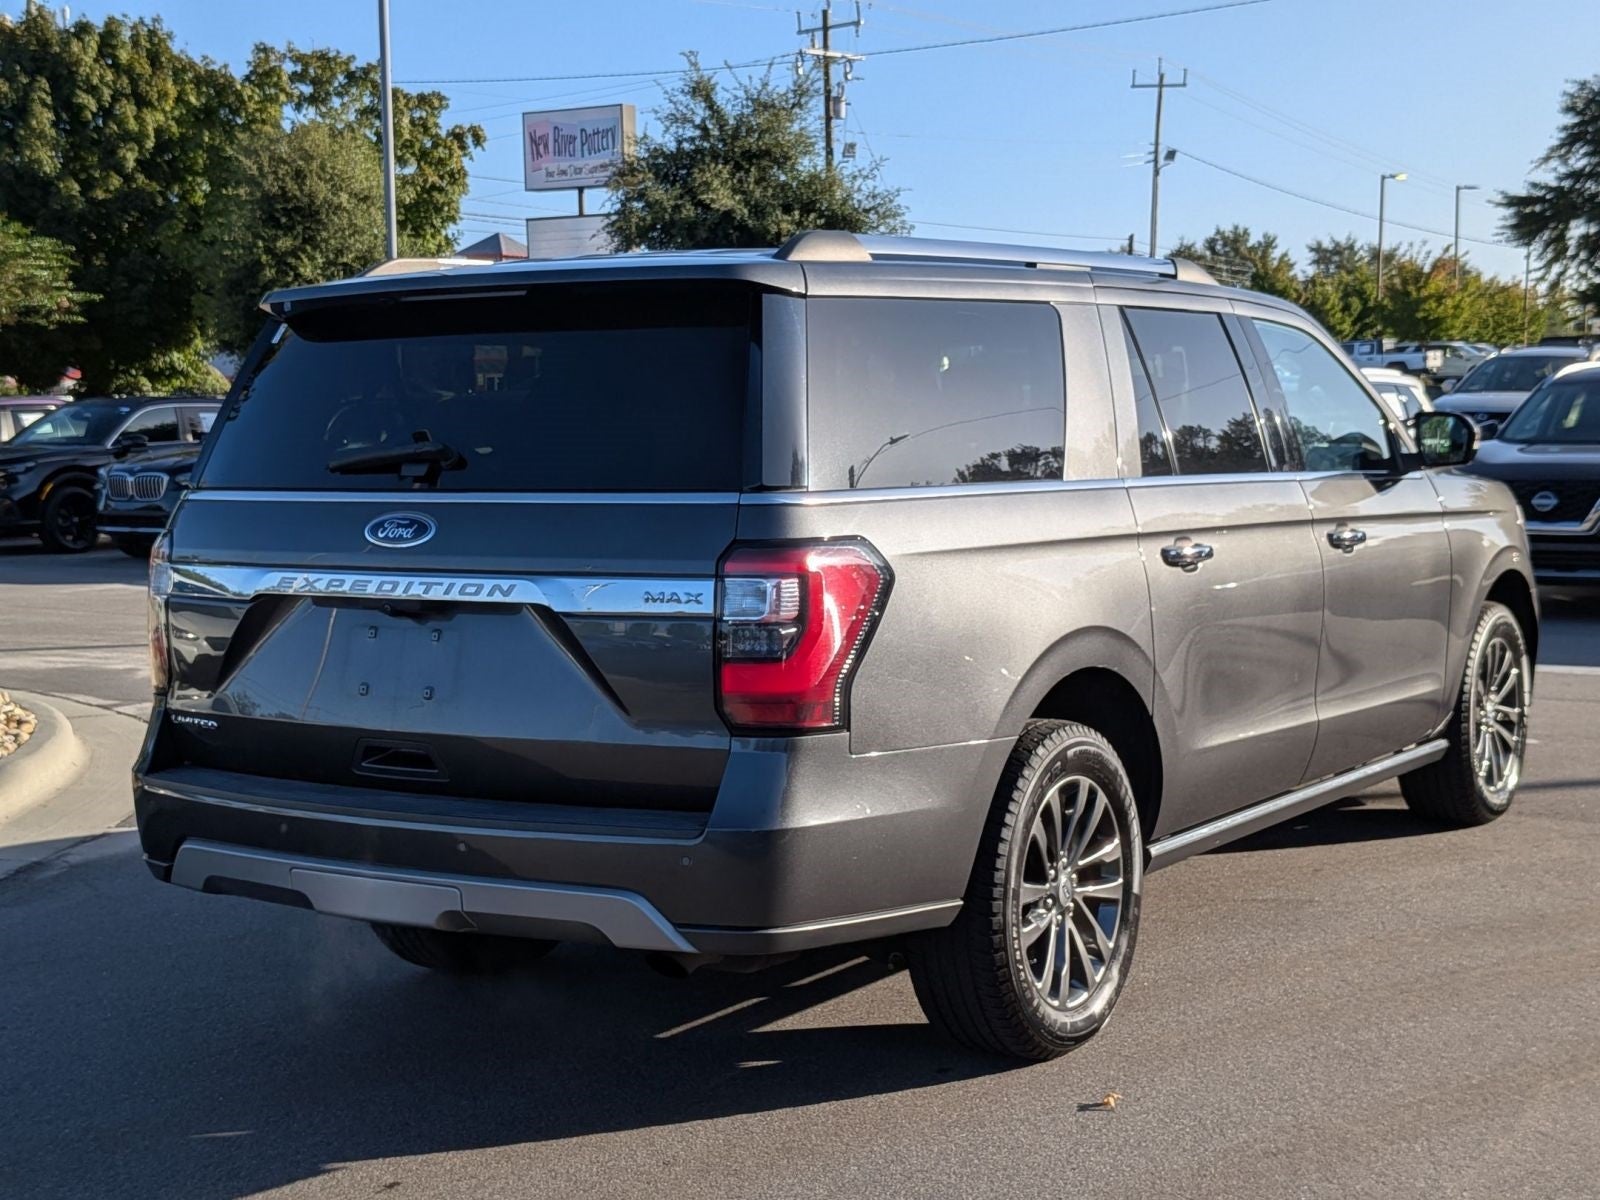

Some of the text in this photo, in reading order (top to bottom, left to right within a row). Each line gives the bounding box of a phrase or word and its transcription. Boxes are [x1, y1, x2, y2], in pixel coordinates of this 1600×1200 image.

[529, 125, 617, 162] New River Pottery
[377, 519, 418, 539] Ford
[276, 576, 517, 597] EXPEDITION
[644, 591, 703, 605] MAX
[171, 714, 218, 729] LIMITED
